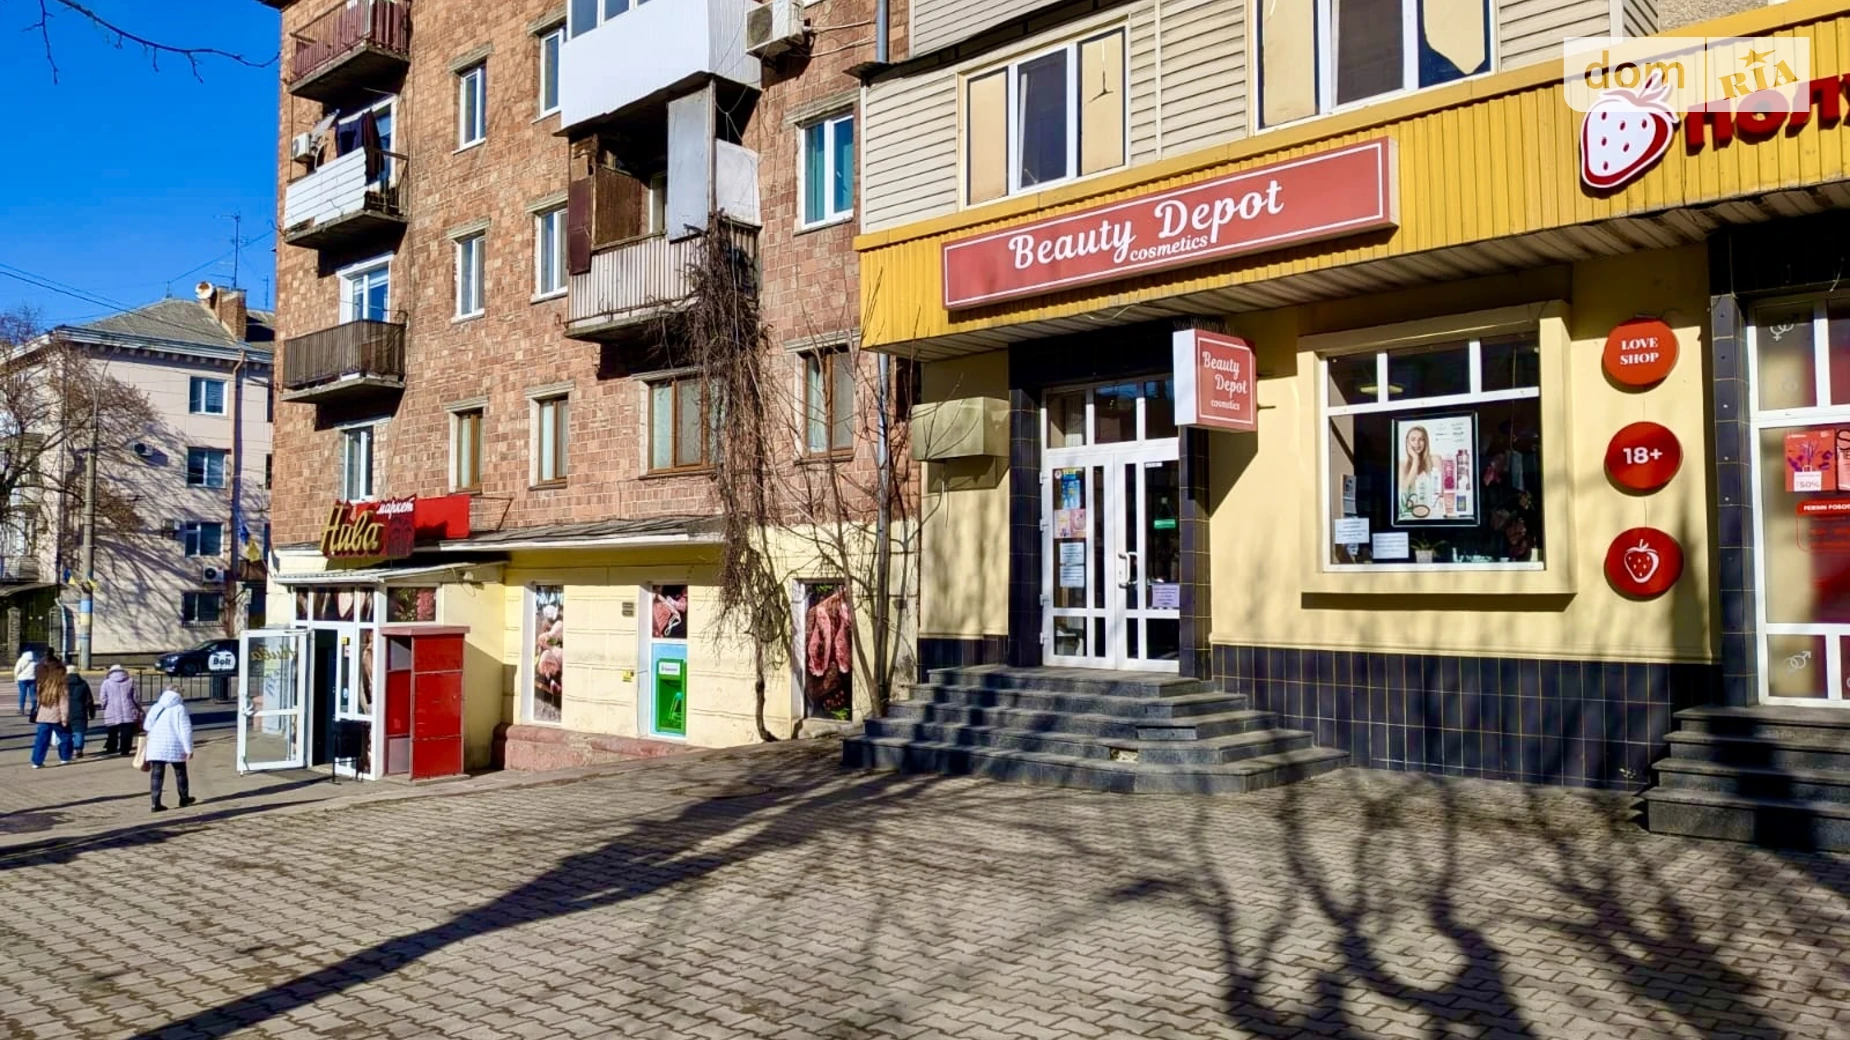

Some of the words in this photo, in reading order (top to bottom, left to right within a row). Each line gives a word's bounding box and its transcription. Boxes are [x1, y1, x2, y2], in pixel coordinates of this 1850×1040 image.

[1685, 73, 1850, 155] ПОЛ
[1008, 218, 1137, 270] Beauty
[1154, 180, 1284, 243] Depot
[1130, 234, 1208, 262] cosmetics
[1621, 337, 1658, 350] LOVE
[1202, 351, 1240, 380] Beauty
[1620, 352, 1659, 365] SHOP
[1214, 374, 1248, 399] Depot
[1210, 399, 1240, 411] cosmetics
[1623, 447, 1663, 464] 18+
[376, 498, 414, 519] маркет
[321, 504, 385, 553] Нива
[213, 657, 232, 666] Bolt
